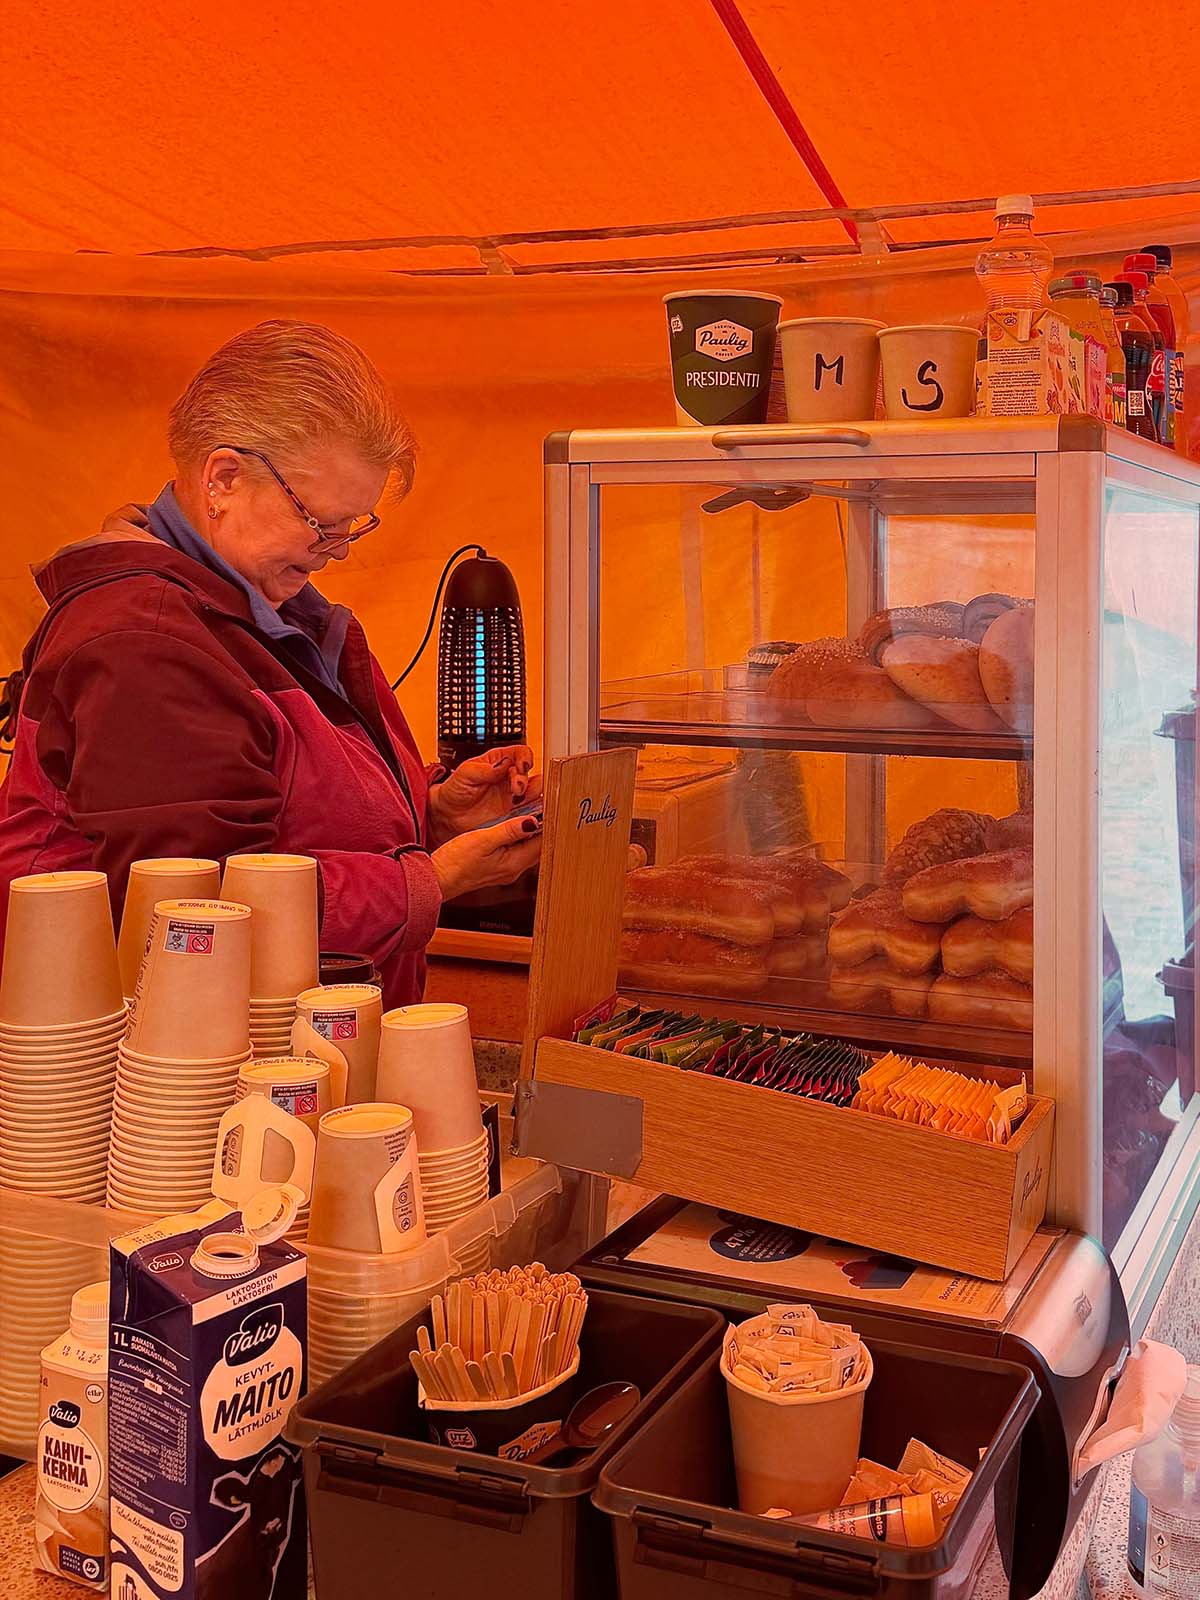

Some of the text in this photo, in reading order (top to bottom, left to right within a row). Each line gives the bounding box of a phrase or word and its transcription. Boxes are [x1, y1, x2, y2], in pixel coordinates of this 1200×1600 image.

[700, 331, 748, 351] Paulig
[686, 371, 760, 388] PRESIDENTTI
[815, 353, 845, 391] M
[901, 360, 943, 411] S
[576, 794, 617, 830] Paulig
[724, 1228, 756, 1248] 47%
[152, 1258, 180, 1270] Valio
[285, 1252, 299, 1260] 1L
[226, 1273, 278, 1300] LAKTOOSITON
[232, 1283, 274, 1306] LAKTOSFRI
[113, 1331, 129, 1347] 1L
[229, 1322, 278, 1358] Valio
[235, 1361, 275, 1388] KEVYT-
[212, 1367, 294, 1434] MAITO
[50, 1407, 78, 1424] Valio
[228, 1407, 283, 1442] LÄTTMJÖLK
[44, 1435, 92, 1466] KAHVI-
[450, 1433, 469, 1441] UTZ
[42, 1455, 89, 1488] KERMA
